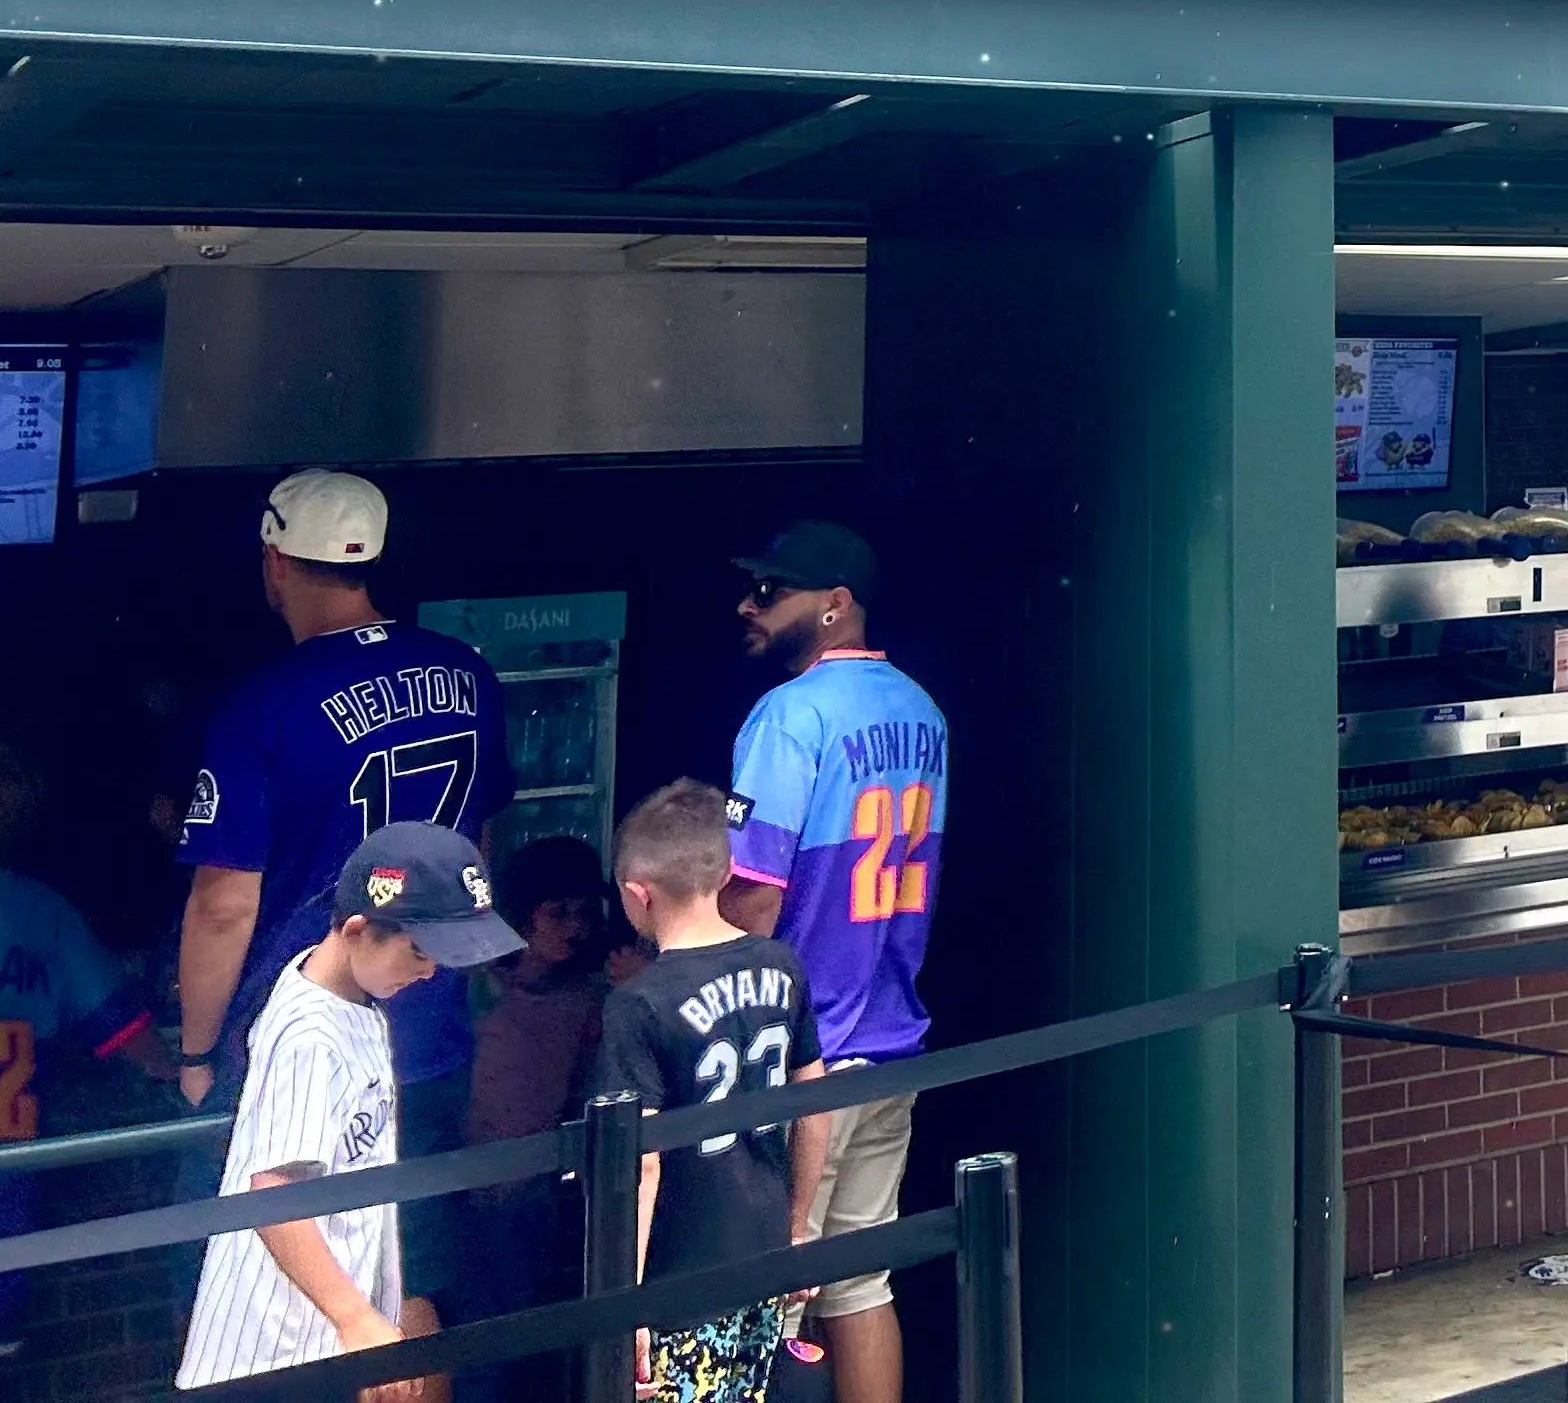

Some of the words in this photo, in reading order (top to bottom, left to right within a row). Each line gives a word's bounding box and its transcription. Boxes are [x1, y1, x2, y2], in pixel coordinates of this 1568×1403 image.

[503, 604, 570, 634] DASANI
[321, 666, 478, 745] HELTON
[350, 730, 477, 840] 17
[842, 721, 945, 784] MONIAK
[850, 783, 934, 923] 22
[678, 966, 795, 1037] BRYANT
[696, 1020, 794, 1158] 23
